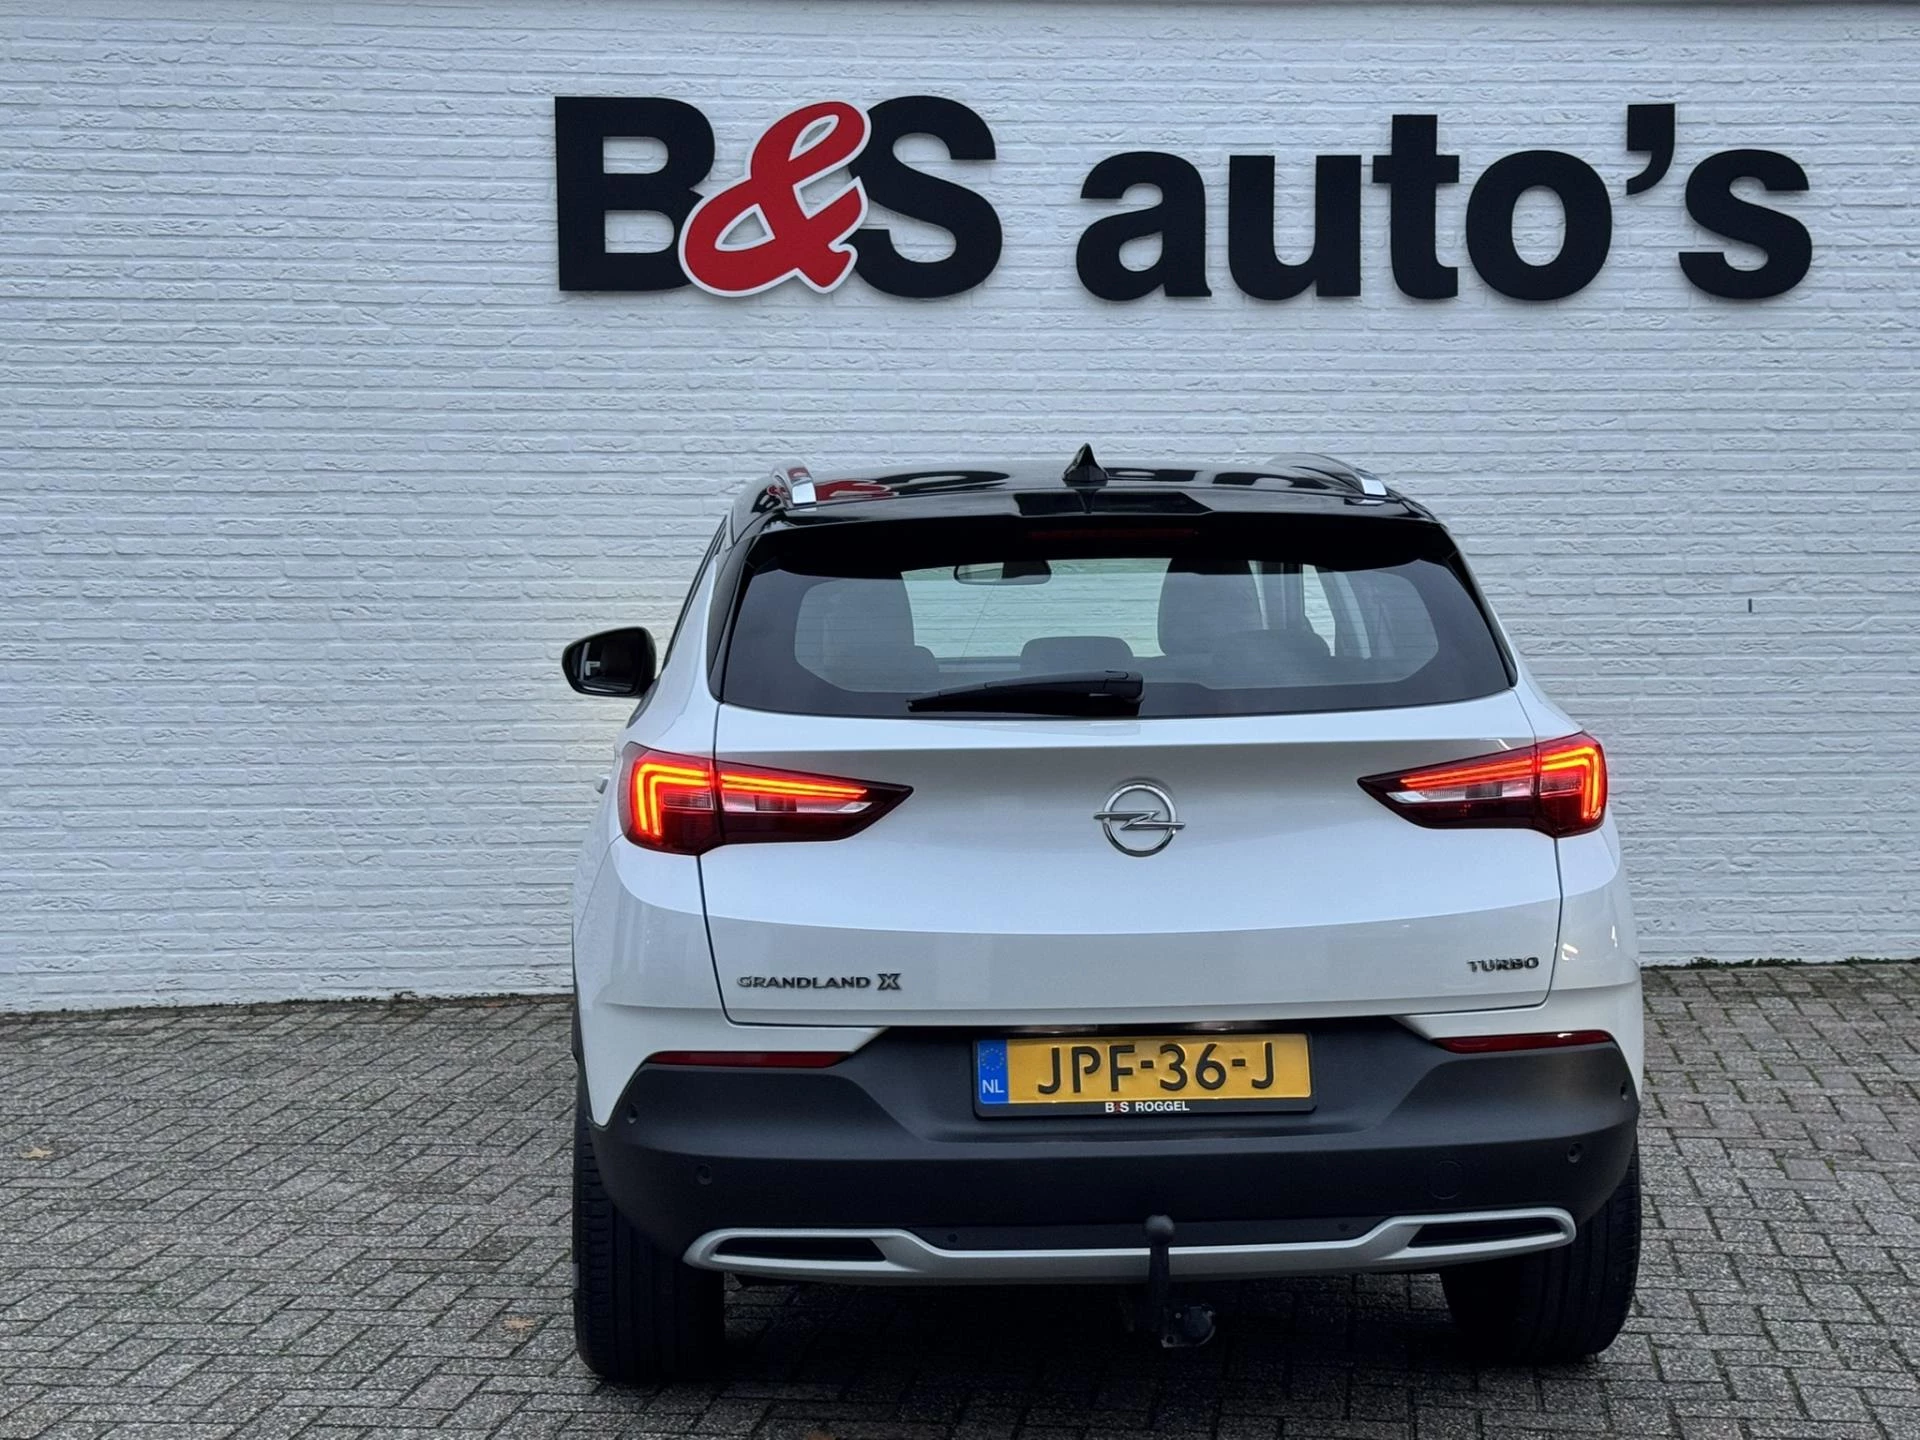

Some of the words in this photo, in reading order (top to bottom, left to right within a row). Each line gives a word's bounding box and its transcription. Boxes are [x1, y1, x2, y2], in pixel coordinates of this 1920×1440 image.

[555, 95, 1003, 299] B&S
[1075, 103, 1813, 302] auto's
[1468, 956, 1540, 973] TURBO
[737, 975, 871, 989] GRANDLAND
[877, 973, 902, 991] X
[1037, 1042, 1275, 1095] JPF-36-J
[982, 1079, 1005, 1094] NL
[1135, 1100, 1190, 1112] ROGGEL
